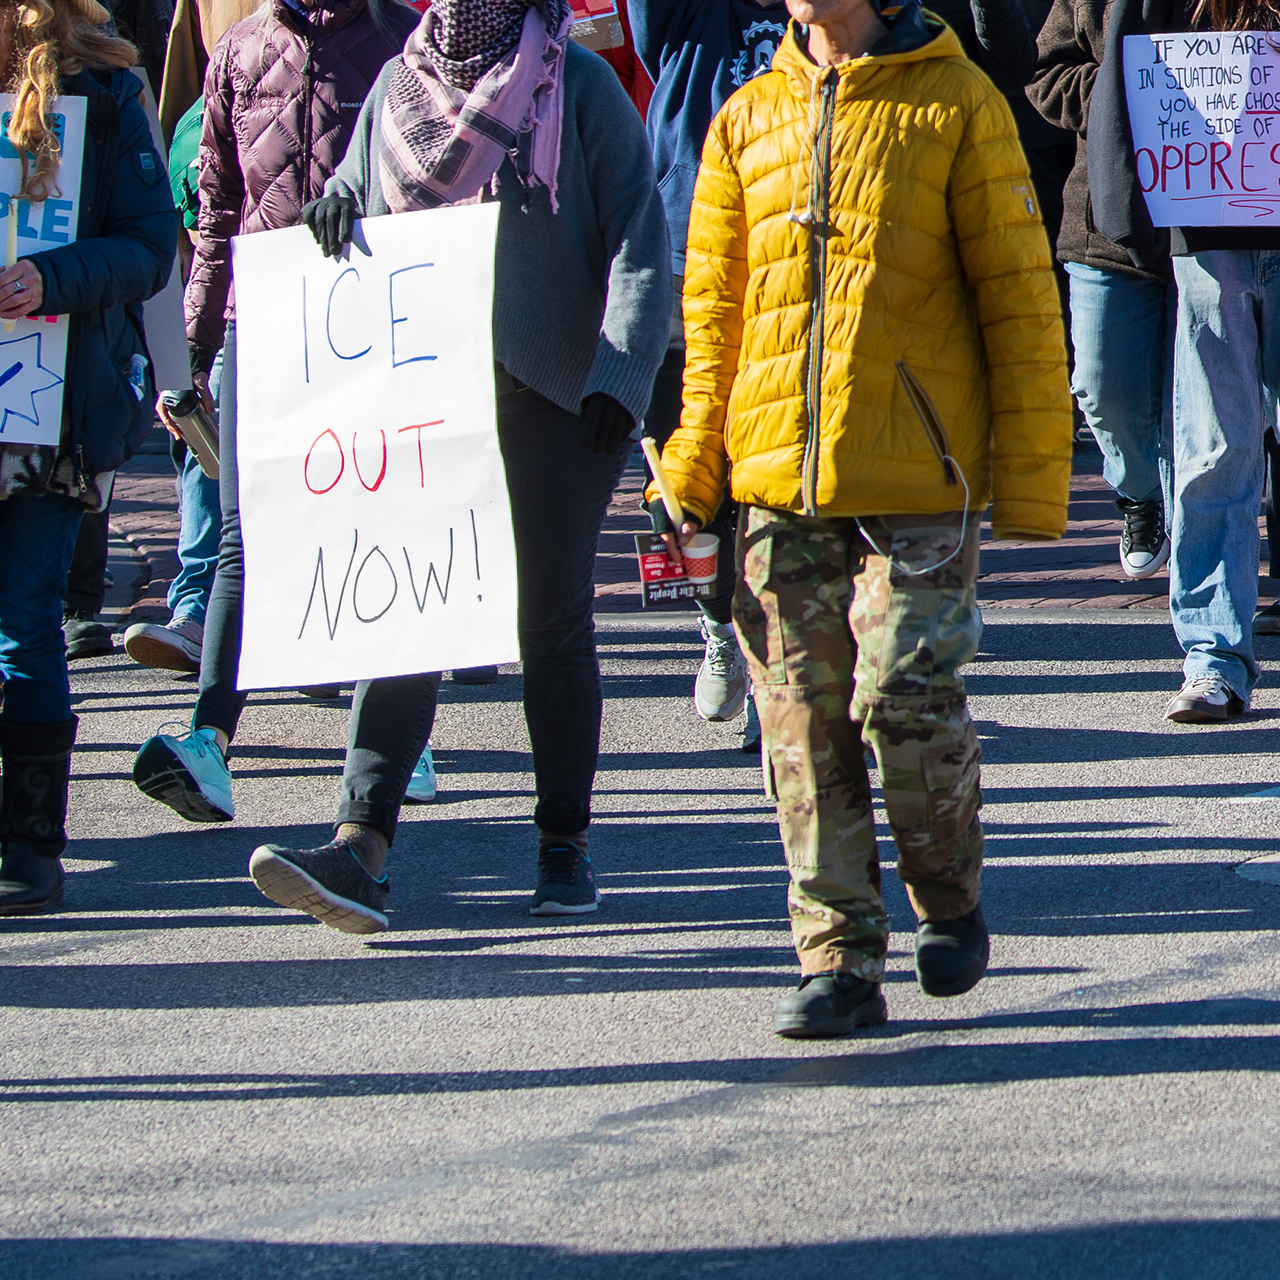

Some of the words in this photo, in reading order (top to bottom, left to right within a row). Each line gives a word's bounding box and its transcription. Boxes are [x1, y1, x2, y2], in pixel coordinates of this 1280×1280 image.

[1152, 39, 1174, 64] IF
[1183, 38, 1221, 60] YOU
[1231, 34, 1267, 56] ARE
[1138, 68, 1155, 90] IN
[1250, 65, 1275, 86] OF
[1206, 92, 1240, 111] HAVE
[1158, 120, 1192, 141] THE
[1204, 117, 1244, 136] SIDE
[1253, 116, 1275, 138] OF
[302, 262, 438, 383] ICE
[303, 420, 445, 495] OUT
[298, 508, 483, 641] NOW!
[649, 586, 678, 601] People
